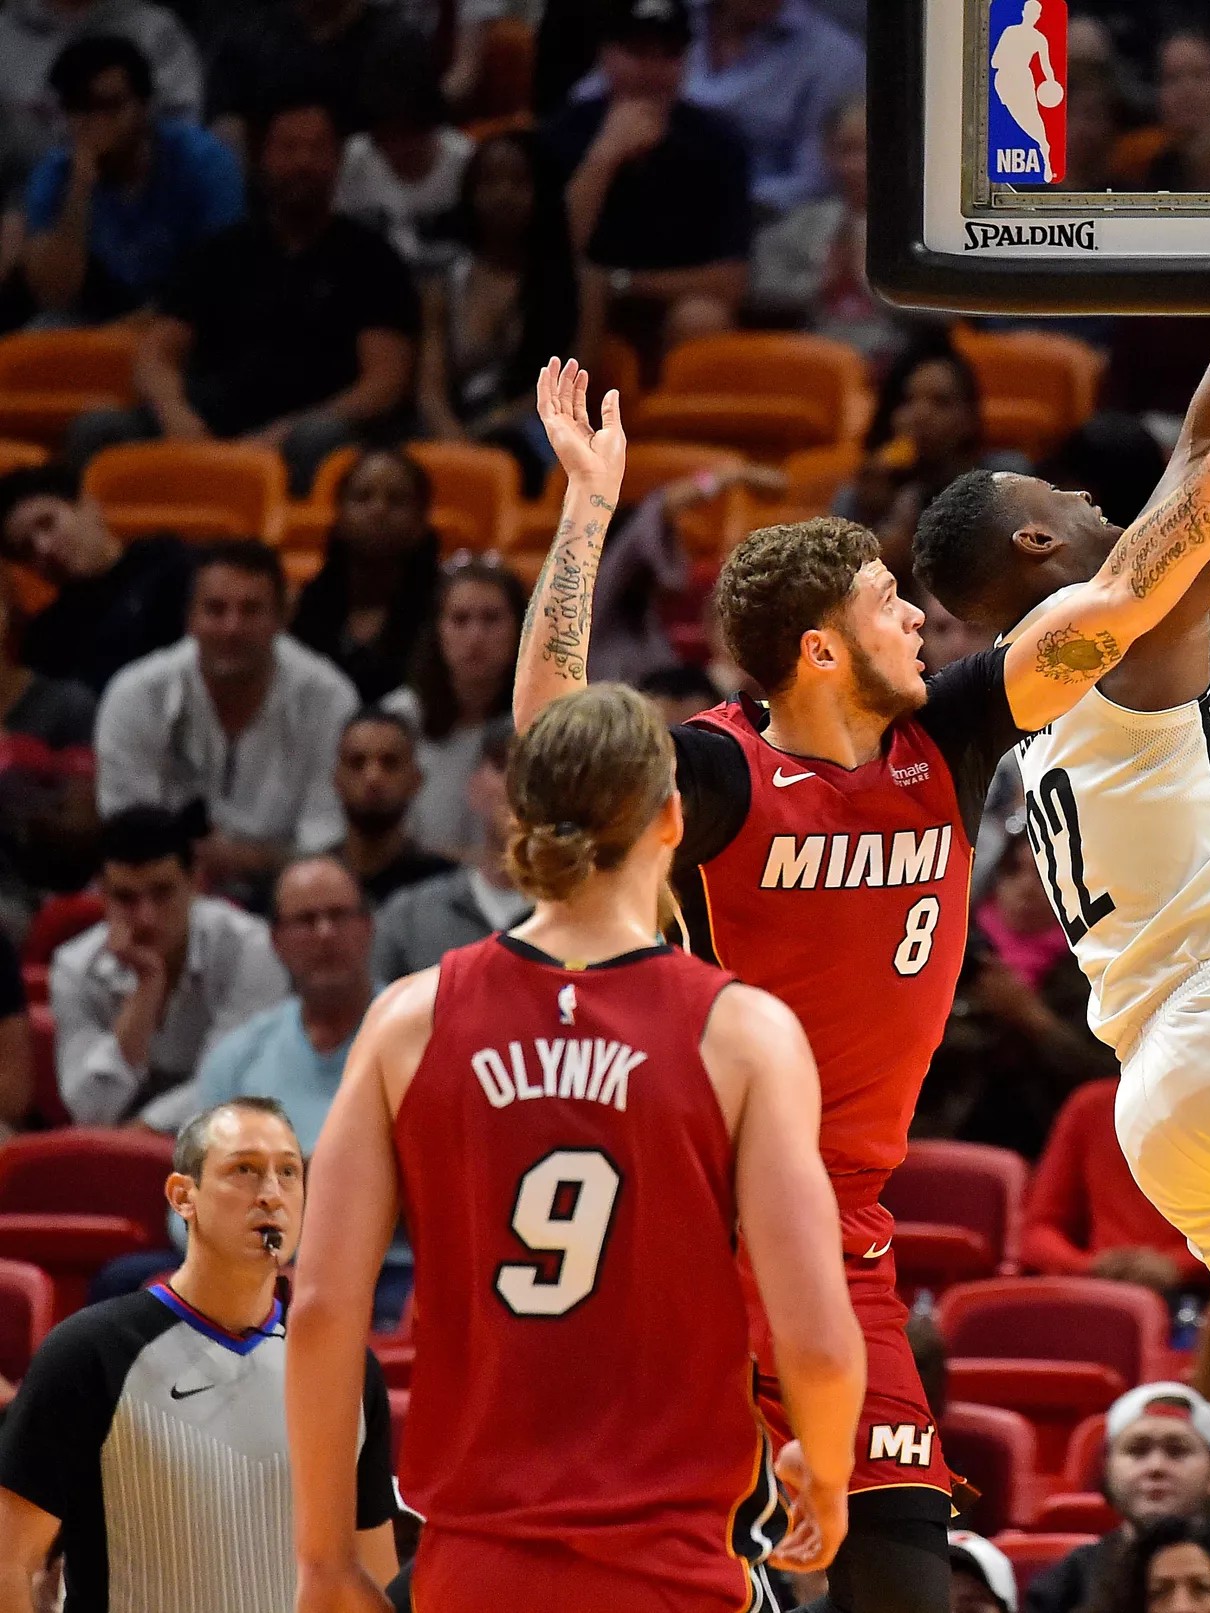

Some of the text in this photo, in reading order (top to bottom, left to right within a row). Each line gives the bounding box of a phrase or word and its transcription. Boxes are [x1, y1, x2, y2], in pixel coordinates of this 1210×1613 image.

[996, 148, 1041, 174] NBA
[964, 220, 1095, 251] SPALDING
[759, 823, 954, 891] MIAMI
[1026, 767, 1117, 947] 22
[893, 897, 940, 979] 8
[471, 1036, 649, 1113] OLYNYK
[496, 1146, 623, 1318] 9
[869, 1424, 935, 1467] MH
